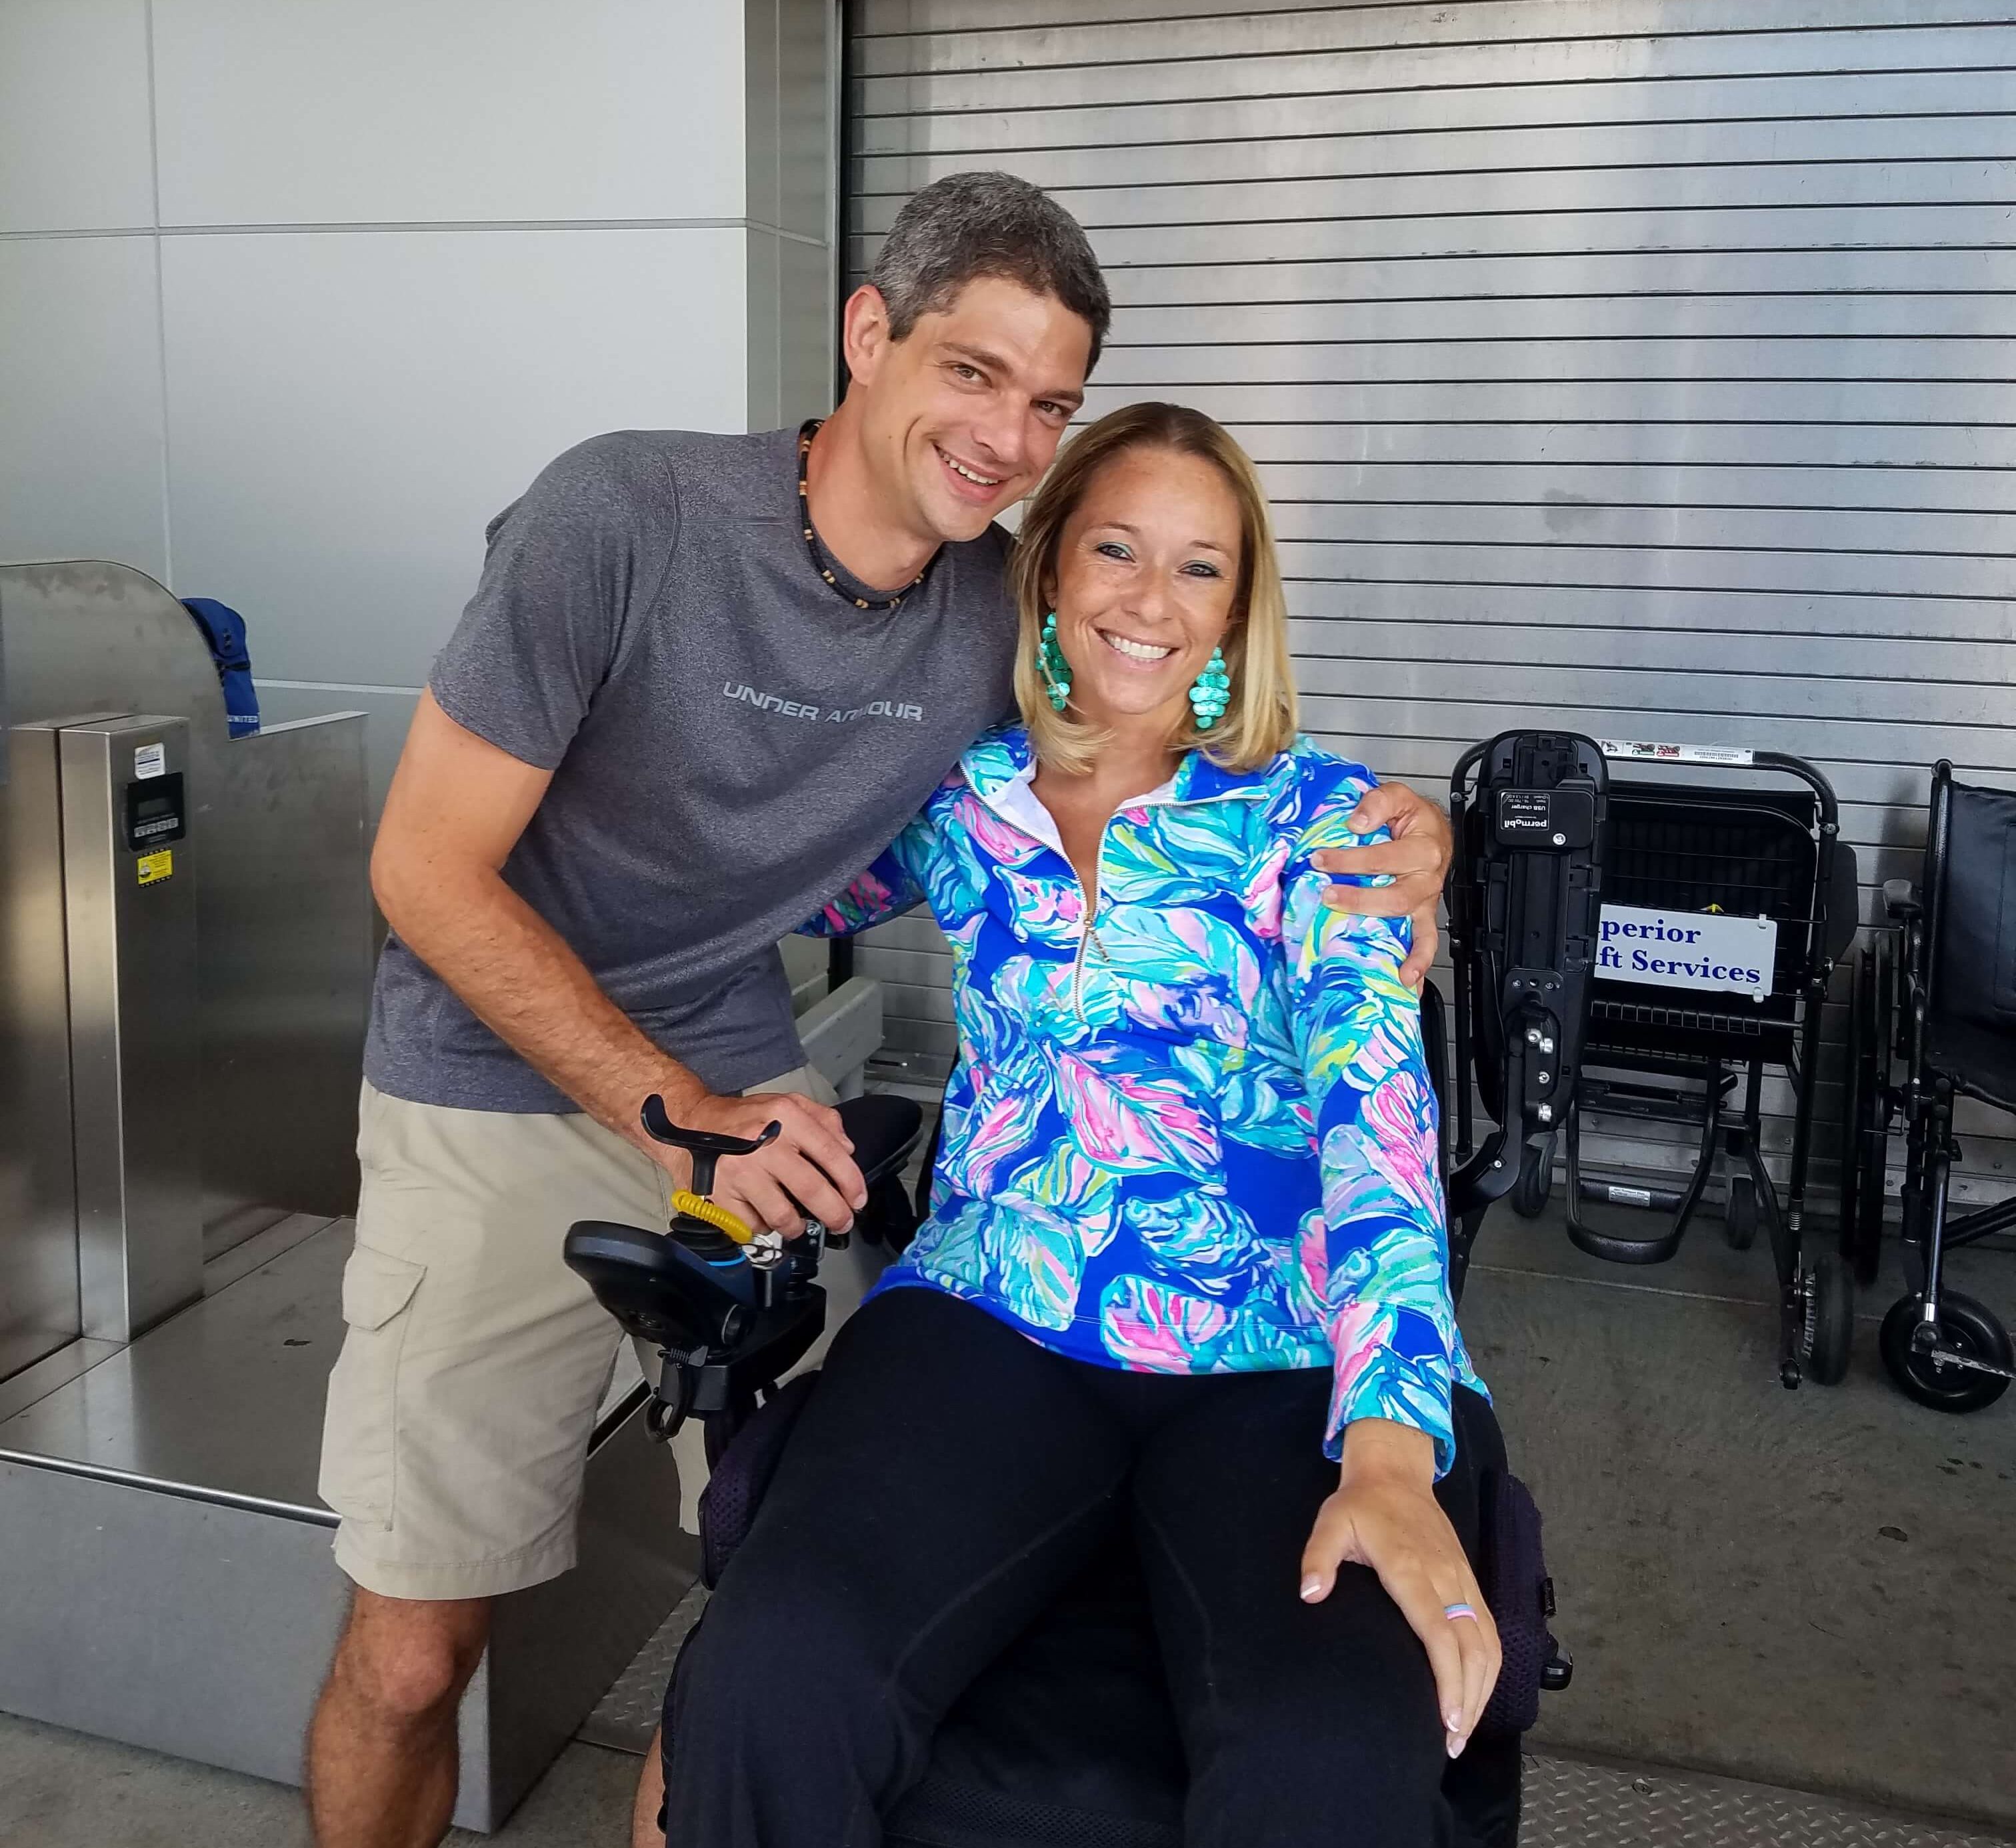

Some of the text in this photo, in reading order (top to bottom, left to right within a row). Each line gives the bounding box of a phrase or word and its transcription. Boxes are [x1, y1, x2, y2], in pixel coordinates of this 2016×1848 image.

[723, 681, 923, 723] UNDER AROUR
[1504, 819, 1547, 828] permobil
[1599, 919, 1701, 944] perior
[1631, 949, 1761, 983] Services
